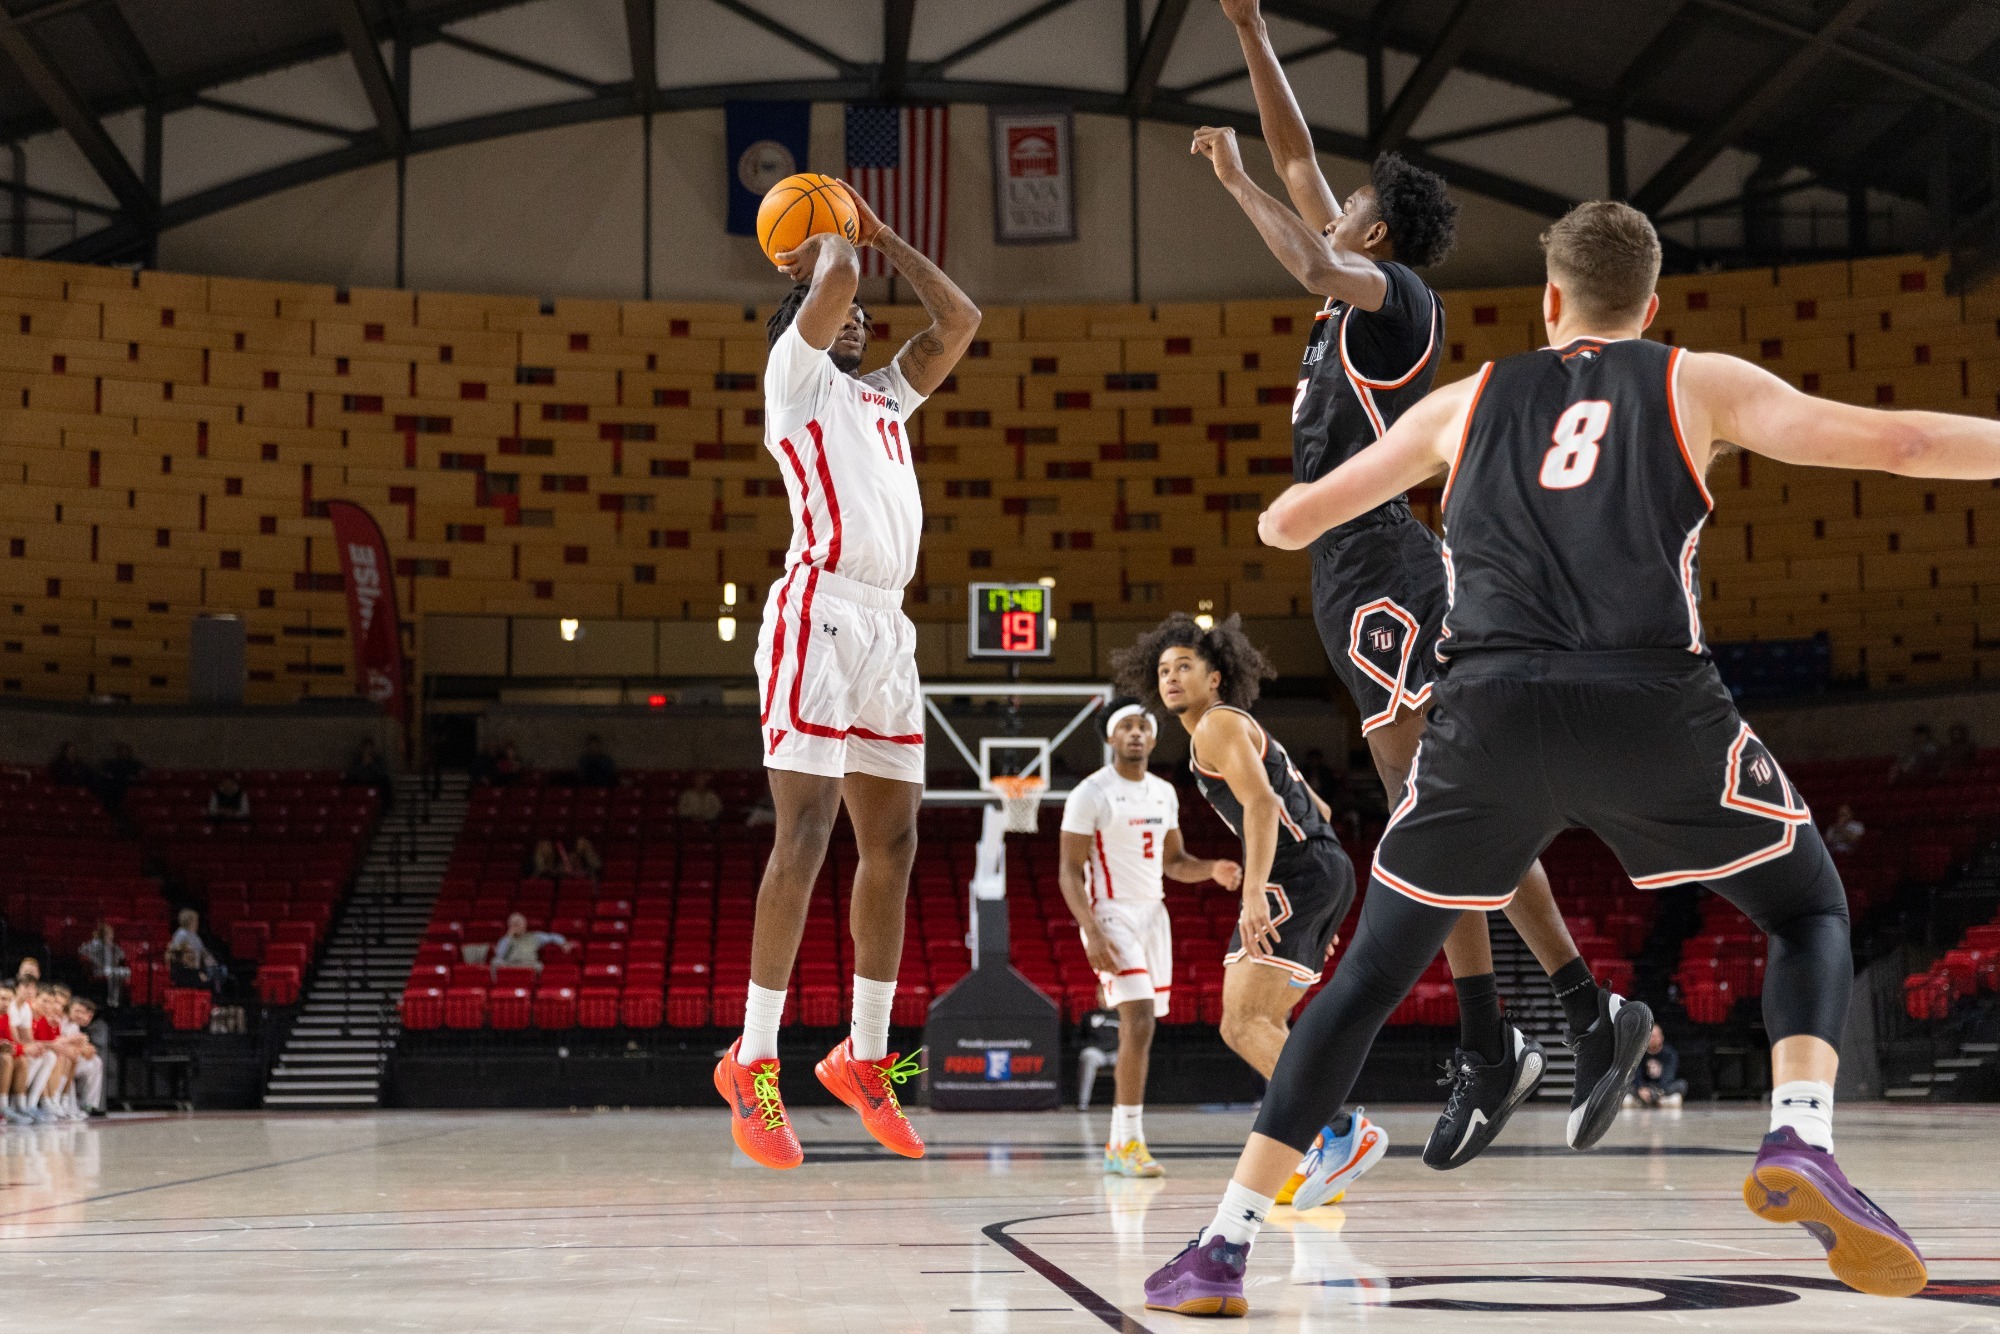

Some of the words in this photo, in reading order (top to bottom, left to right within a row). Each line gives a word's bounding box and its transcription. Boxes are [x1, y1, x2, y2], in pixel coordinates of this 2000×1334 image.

[876, 417, 904, 465] 11
[1538, 399, 1612, 490] 8
[1002, 611, 1037, 651] 19
[1367, 626, 1395, 652] TU
[1747, 753, 1773, 786] TU
[1143, 831, 1154, 859] 2
